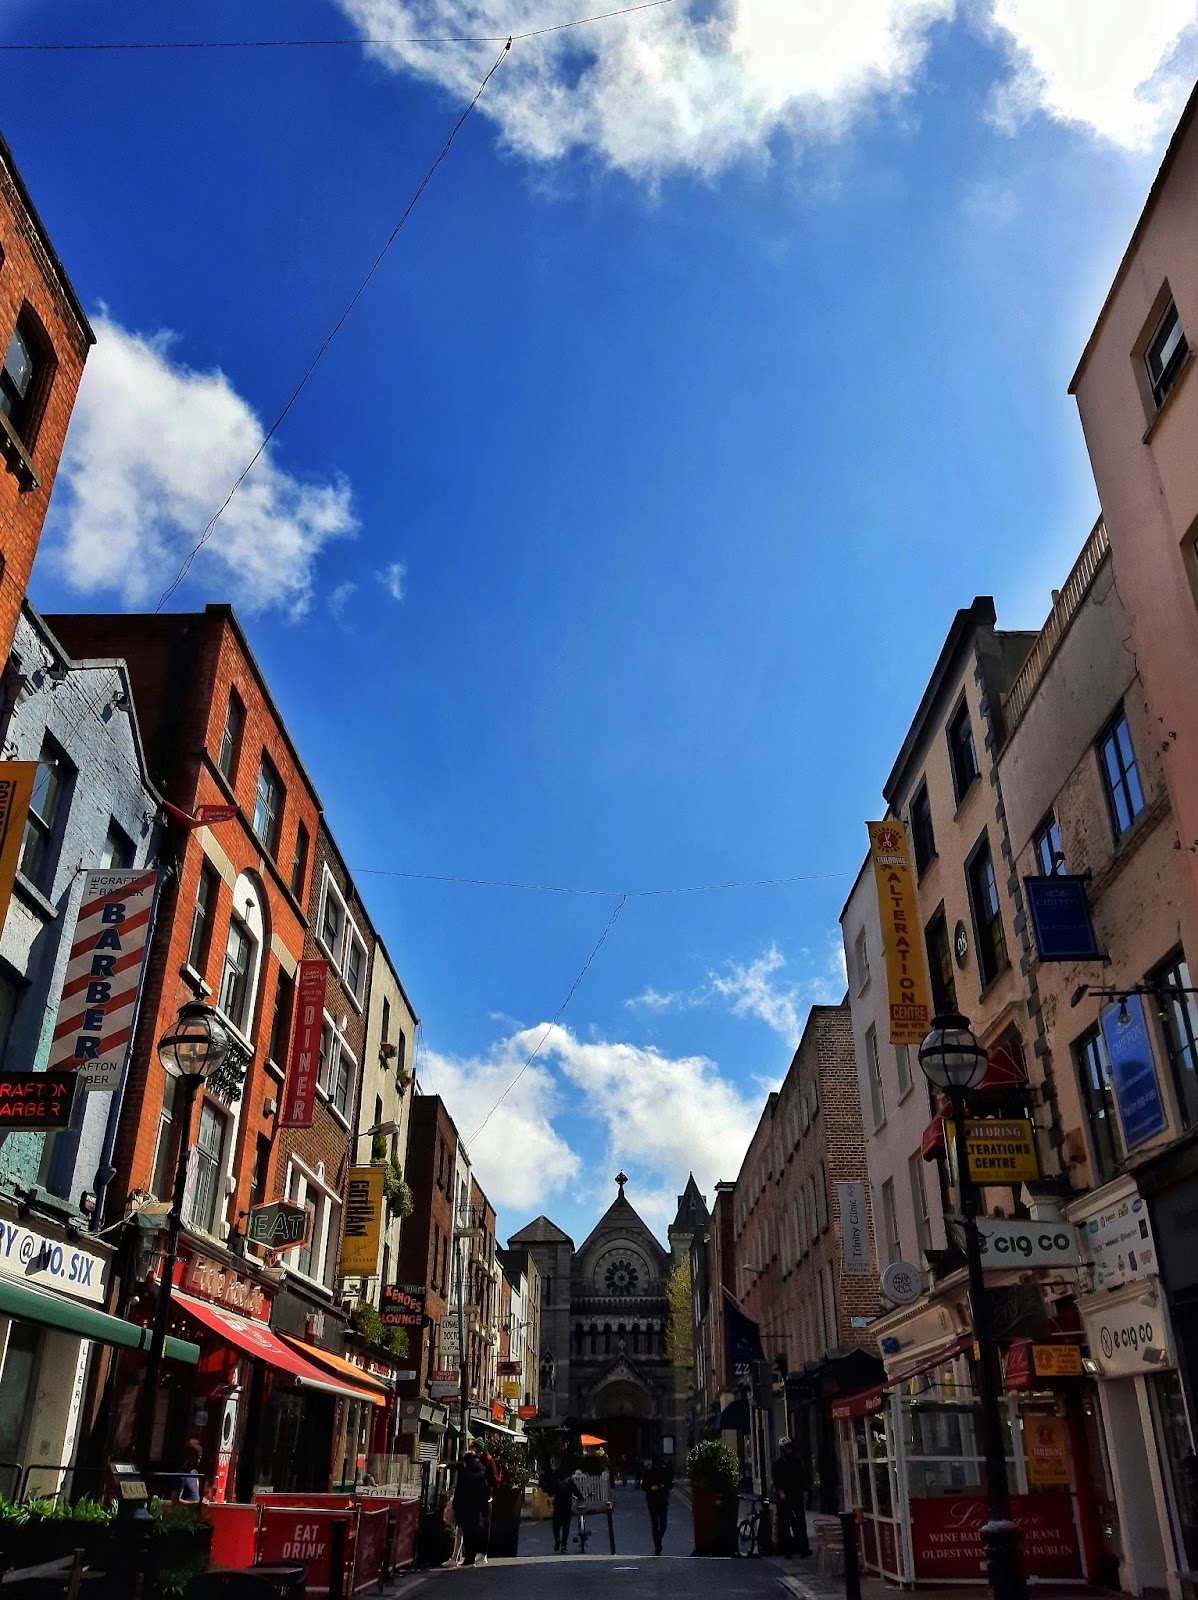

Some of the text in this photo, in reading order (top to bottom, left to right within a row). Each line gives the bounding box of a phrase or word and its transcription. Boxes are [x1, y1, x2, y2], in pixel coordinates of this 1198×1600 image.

[90, 877, 101, 895] THE
[888, 872, 915, 1004] ALTERATION
[74, 902, 126, 1059] BARBER
[893, 1006, 926, 1019] CENTRE
[292, 1006, 315, 1119] DINER
[969, 1127, 1021, 1137] AILORING
[966, 1144, 1030, 1155] TERATIONS
[975, 1158, 1016, 1168] CENTRE
[253, 1210, 304, 1239] EAT
[849, 1199, 861, 1259] Trinity Clinic
[994, 1236, 1032, 1257] cig
[1038, 1233, 1070, 1251] co
[68, 1253, 94, 1286] SIX
[385, 1285, 422, 1312] KEHOES
[381, 1314, 423, 1325] LOUNGE
[443, 1331, 460, 1340] DOCTO
[1121, 1326, 1138, 1351] cig
[1139, 1322, 1153, 1343] co
[294, 1524, 320, 1541] EAT
[929, 1533, 959, 1543] WINE
[282, 1542, 326, 1560] DRINK
[921, 1549, 961, 1559] OLDEST
[964, 1548, 987, 1558] WIN
[1032, 1546, 1072, 1556] DUBLIN
